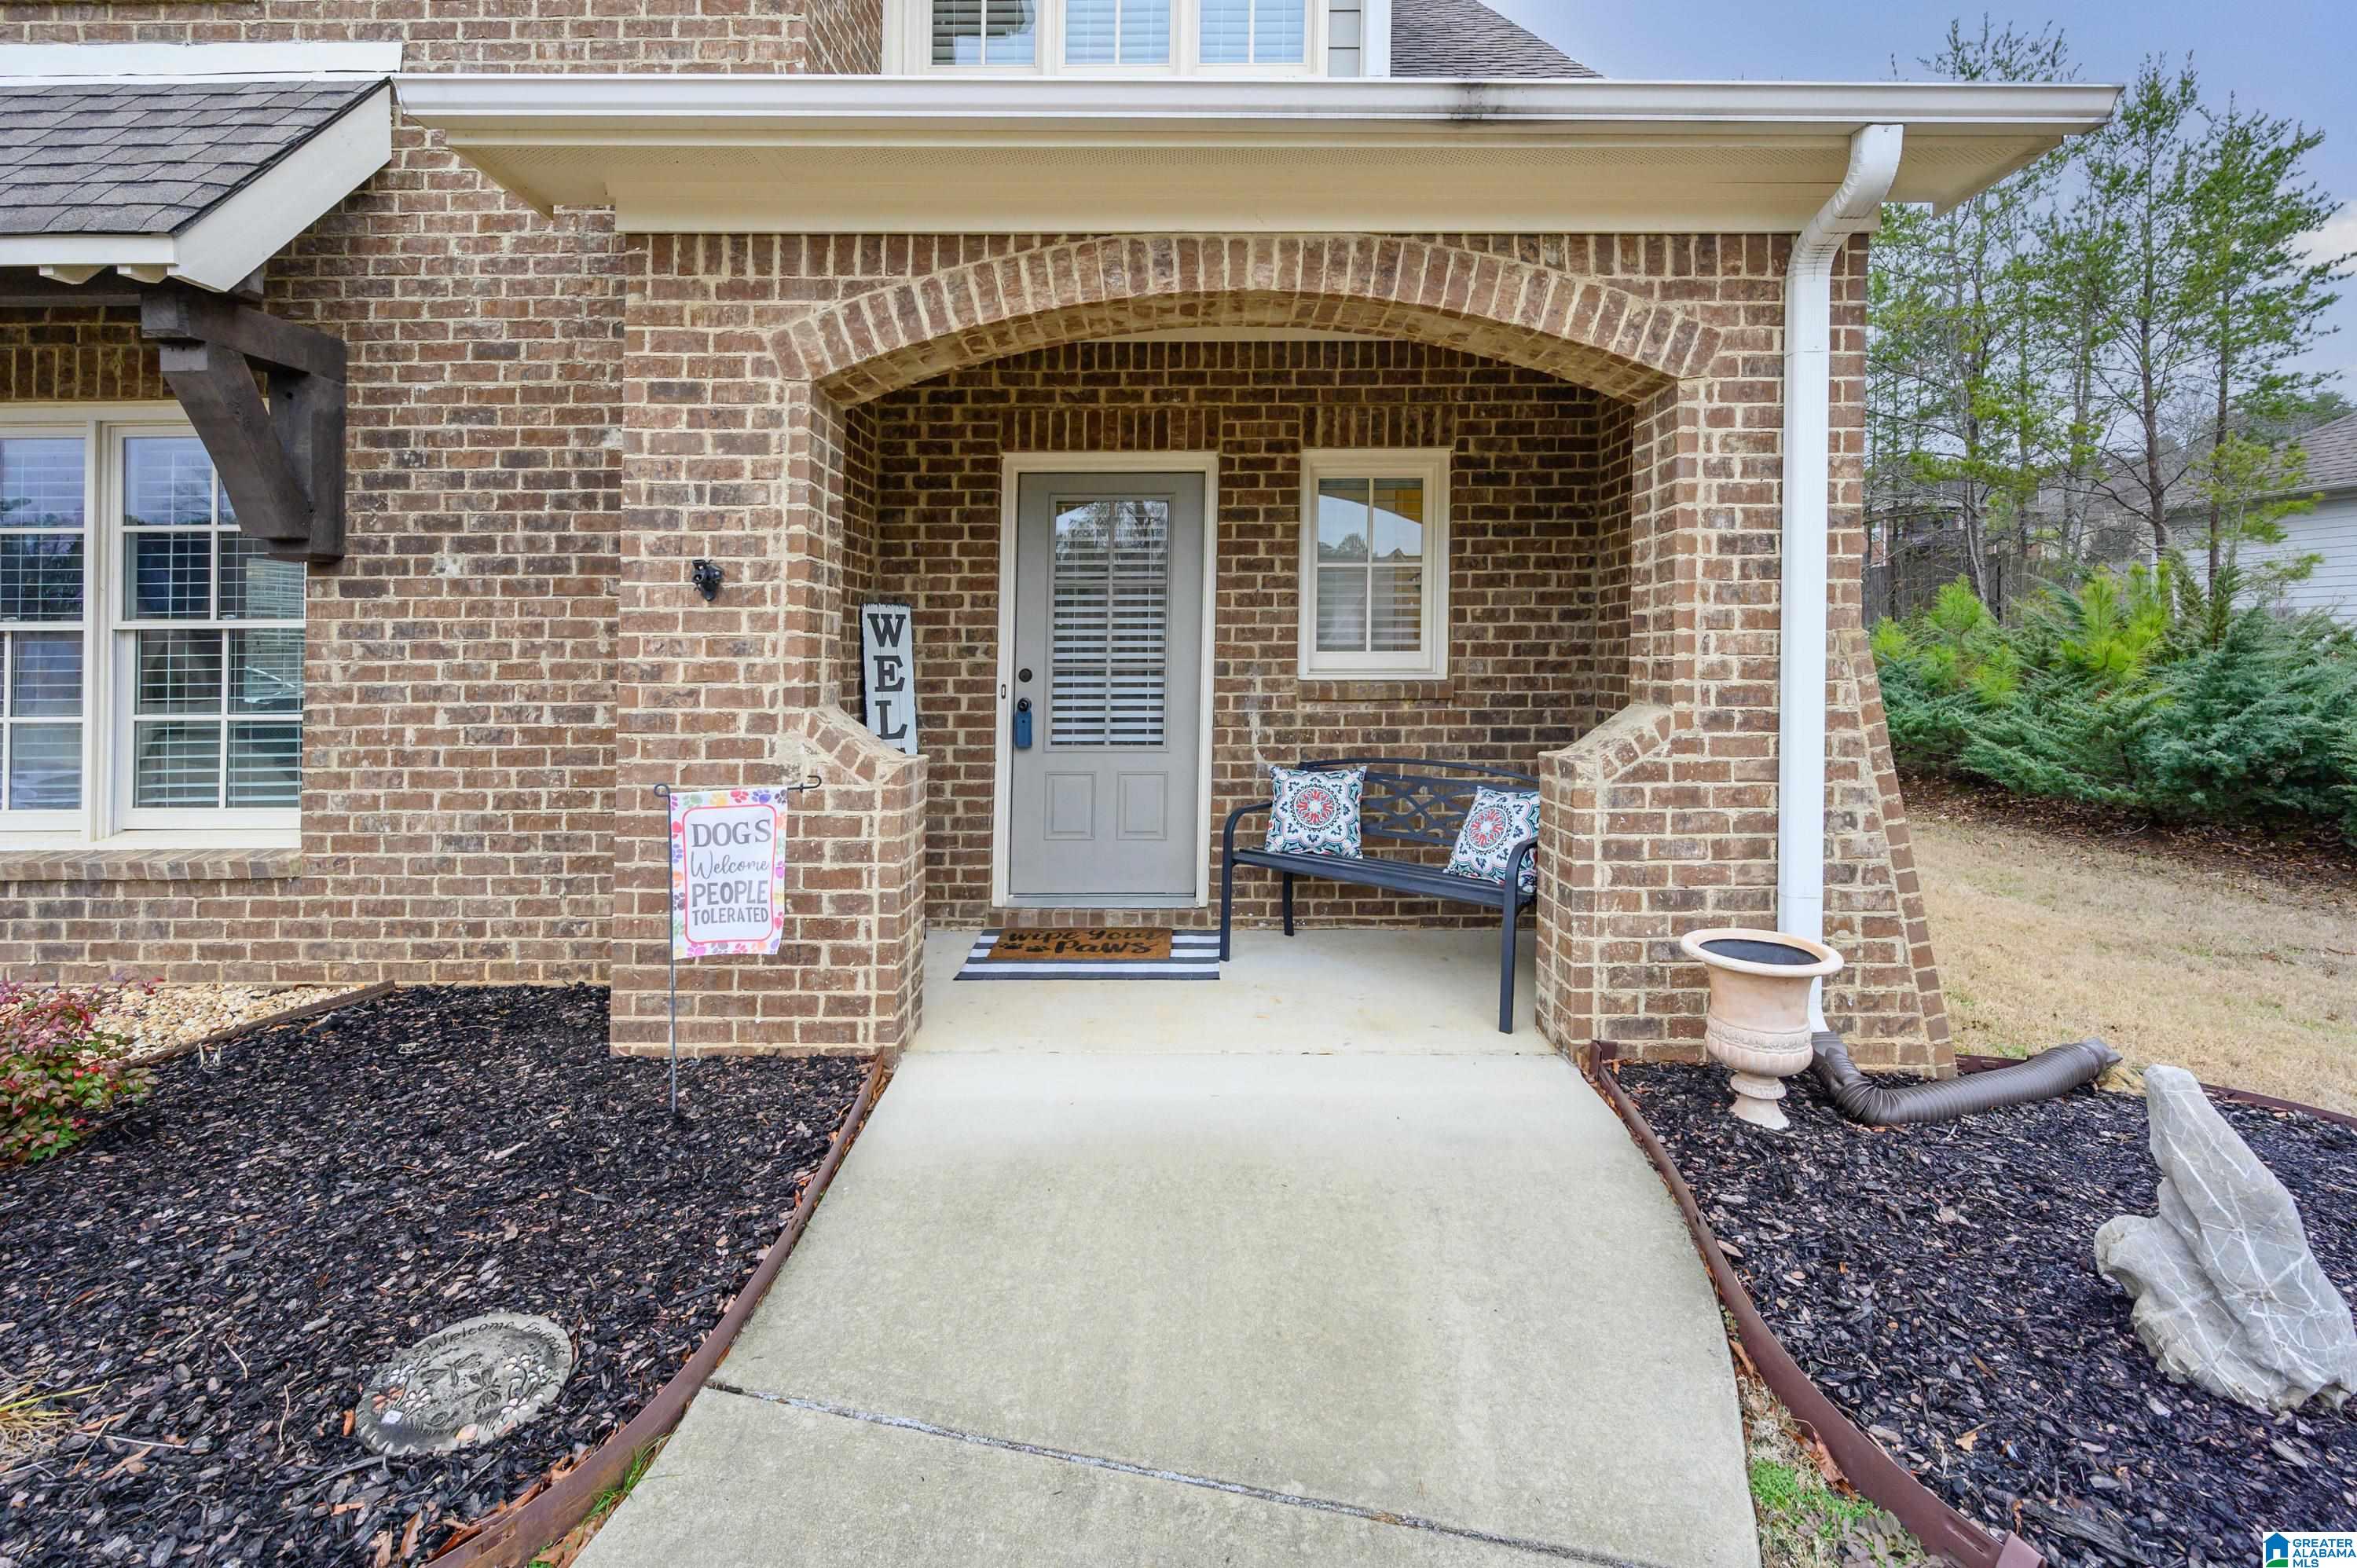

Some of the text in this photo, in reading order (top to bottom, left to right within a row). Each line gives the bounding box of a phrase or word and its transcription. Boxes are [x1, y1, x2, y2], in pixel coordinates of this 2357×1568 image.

[867, 614, 908, 754] WEL
[691, 819, 772, 848] DOGS
[691, 850, 769, 880] Welcome
[691, 880, 768, 907] PEOPLE
[692, 907, 768, 926] TOLERATED
[427, 1321, 515, 1350] Welcome
